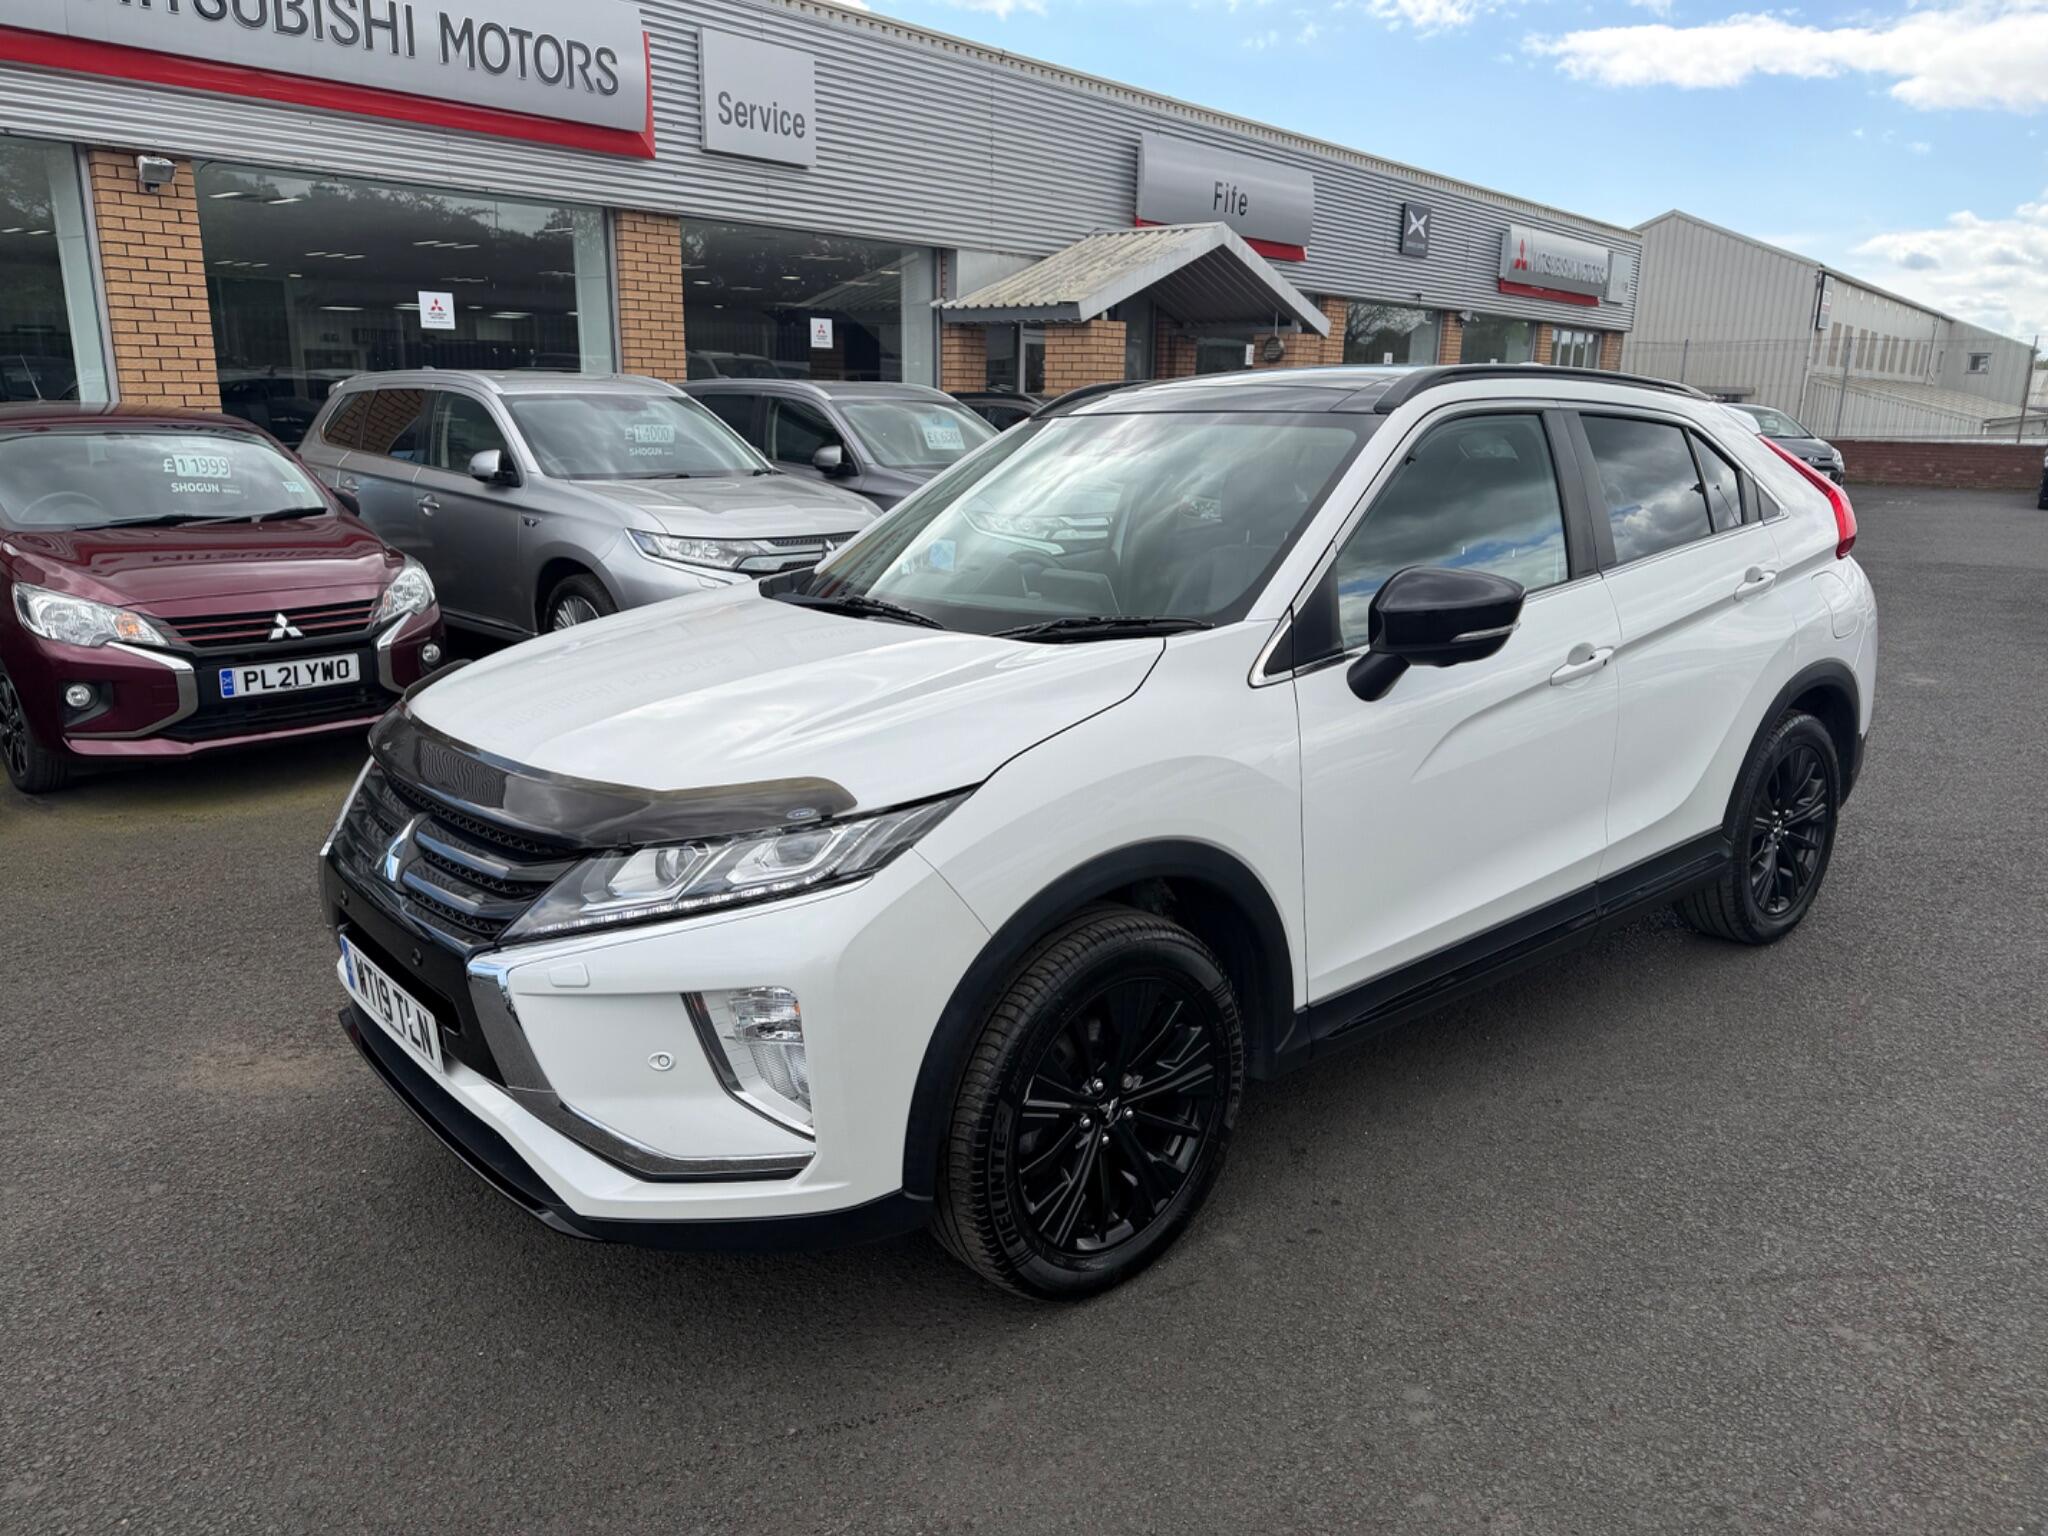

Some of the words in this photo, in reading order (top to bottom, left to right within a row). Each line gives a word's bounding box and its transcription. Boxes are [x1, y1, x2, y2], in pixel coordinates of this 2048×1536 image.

[86, 0, 416, 58] UBISHI
[437, 11, 620, 96] MOTORS
[718, 90, 806, 139] Service
[1212, 180, 1249, 216] Fife
[170, 482, 220, 493] SHOGUN
[243, 665, 299, 692] PL21
[305, 659, 350, 684] YWO
[392, 988, 435, 1062] TLN
